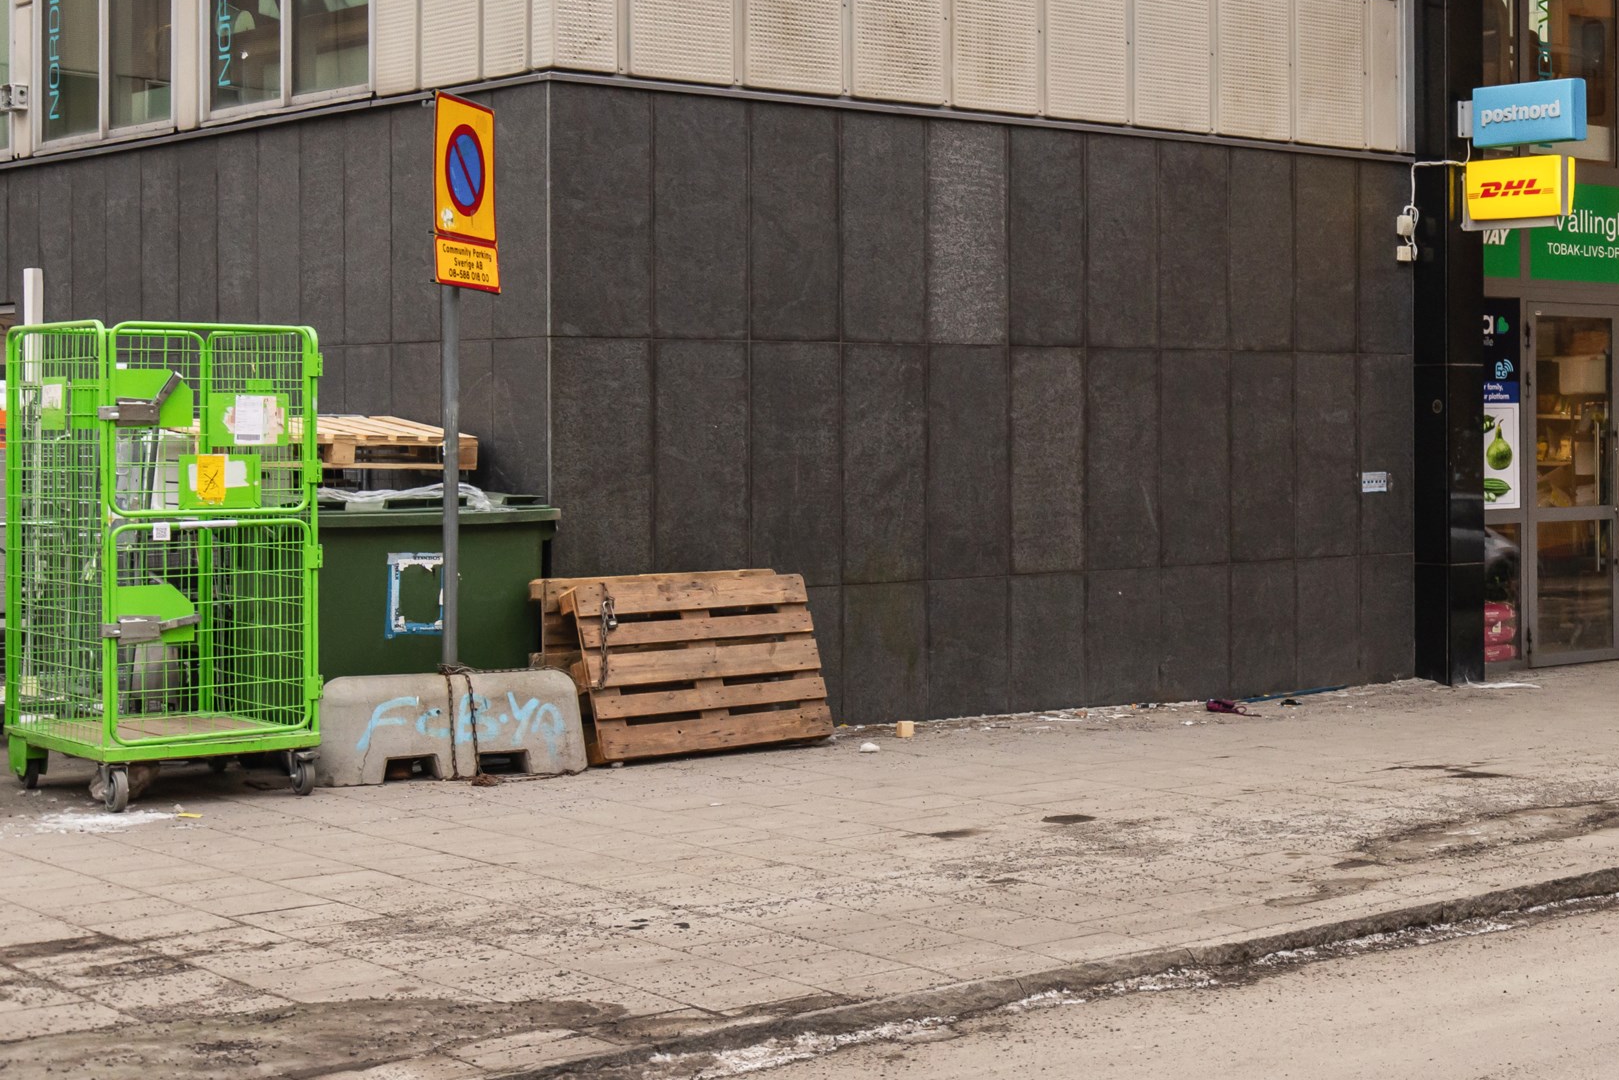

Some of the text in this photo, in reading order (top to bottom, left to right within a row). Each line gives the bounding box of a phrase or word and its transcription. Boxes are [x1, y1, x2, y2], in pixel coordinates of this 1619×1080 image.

[1481, 99, 1561, 128] postnord
[1480, 178, 1542, 199] DHL
[442, 243, 492, 263] Community Parking
[453, 257, 483, 270] Sverige AB
